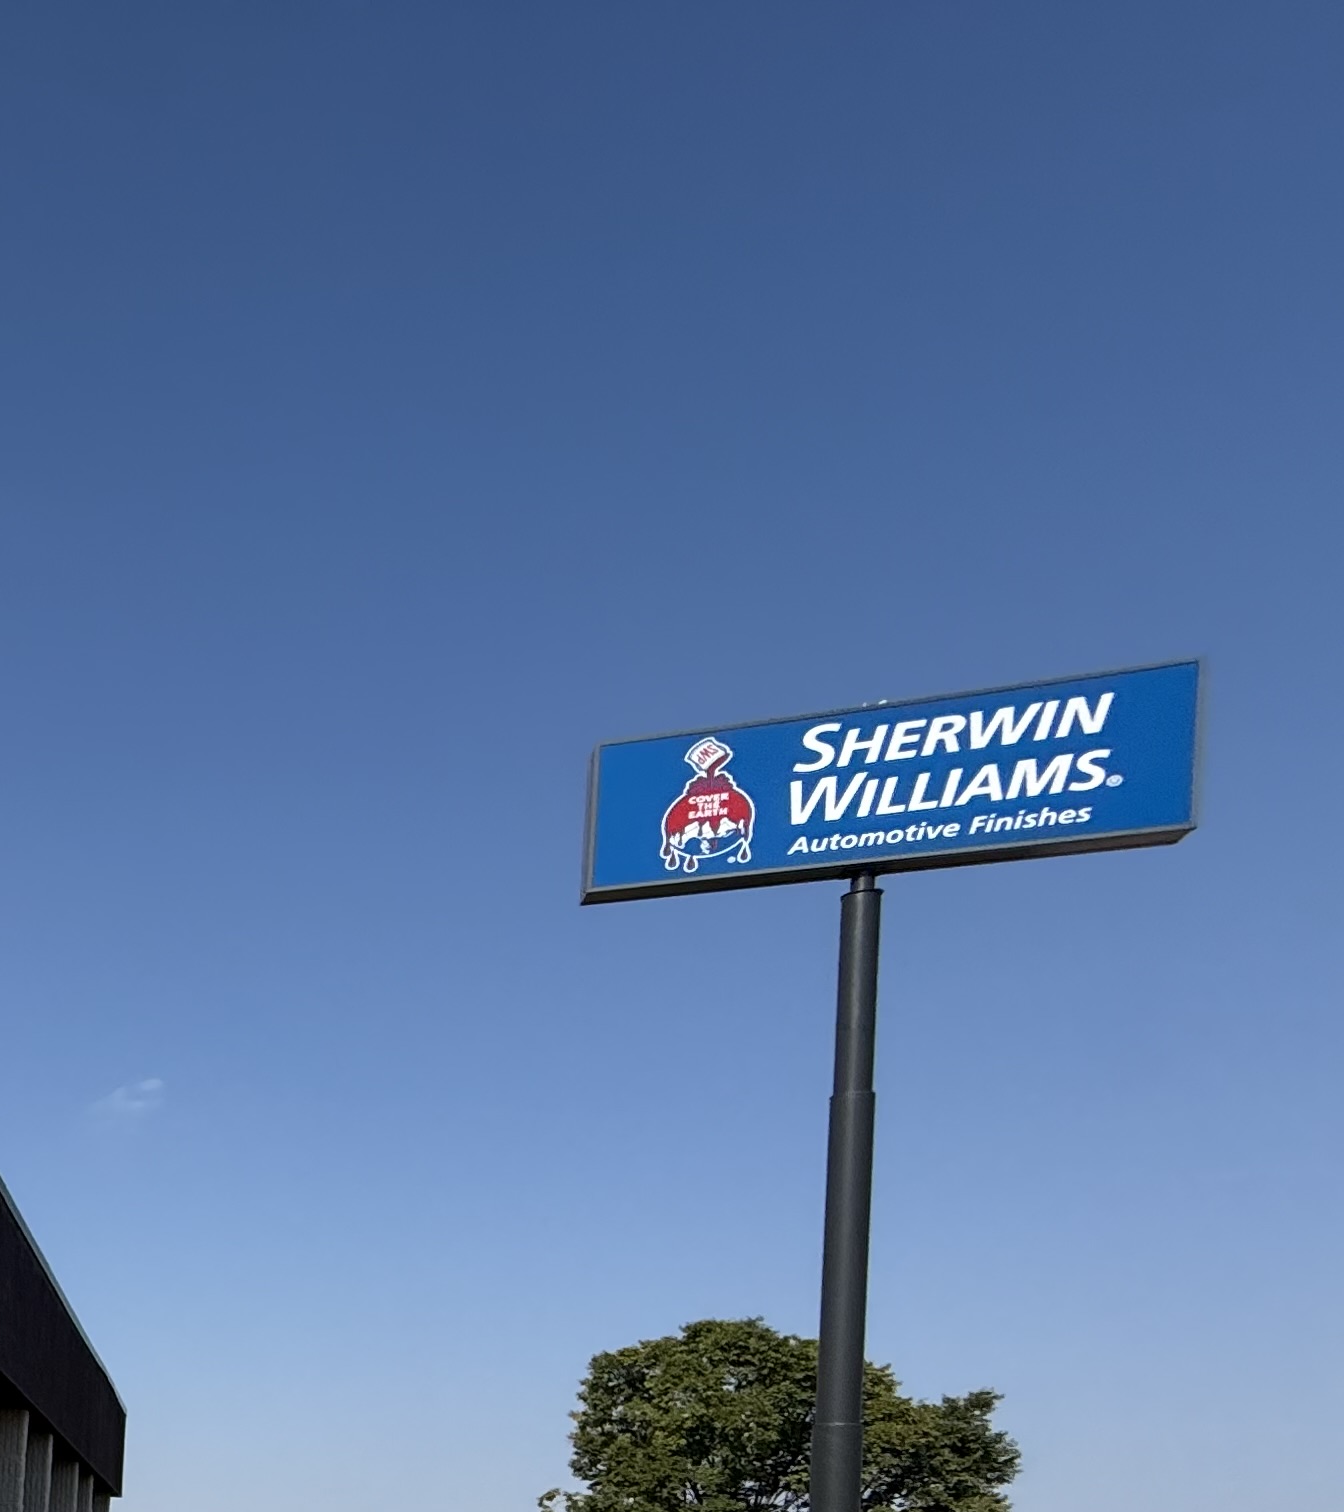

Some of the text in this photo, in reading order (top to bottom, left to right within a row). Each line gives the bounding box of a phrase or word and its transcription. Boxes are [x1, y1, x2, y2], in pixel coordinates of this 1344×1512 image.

[791, 691, 1115, 774] SHERWIN
[697, 743, 720, 765] SWP
[789, 748, 1113, 826] WILLIAMS
[688, 792, 730, 805] COVER
[697, 801, 721, 810] THE
[688, 807, 728, 819] EARTH
[786, 805, 1093, 856] Automotive Finishes
